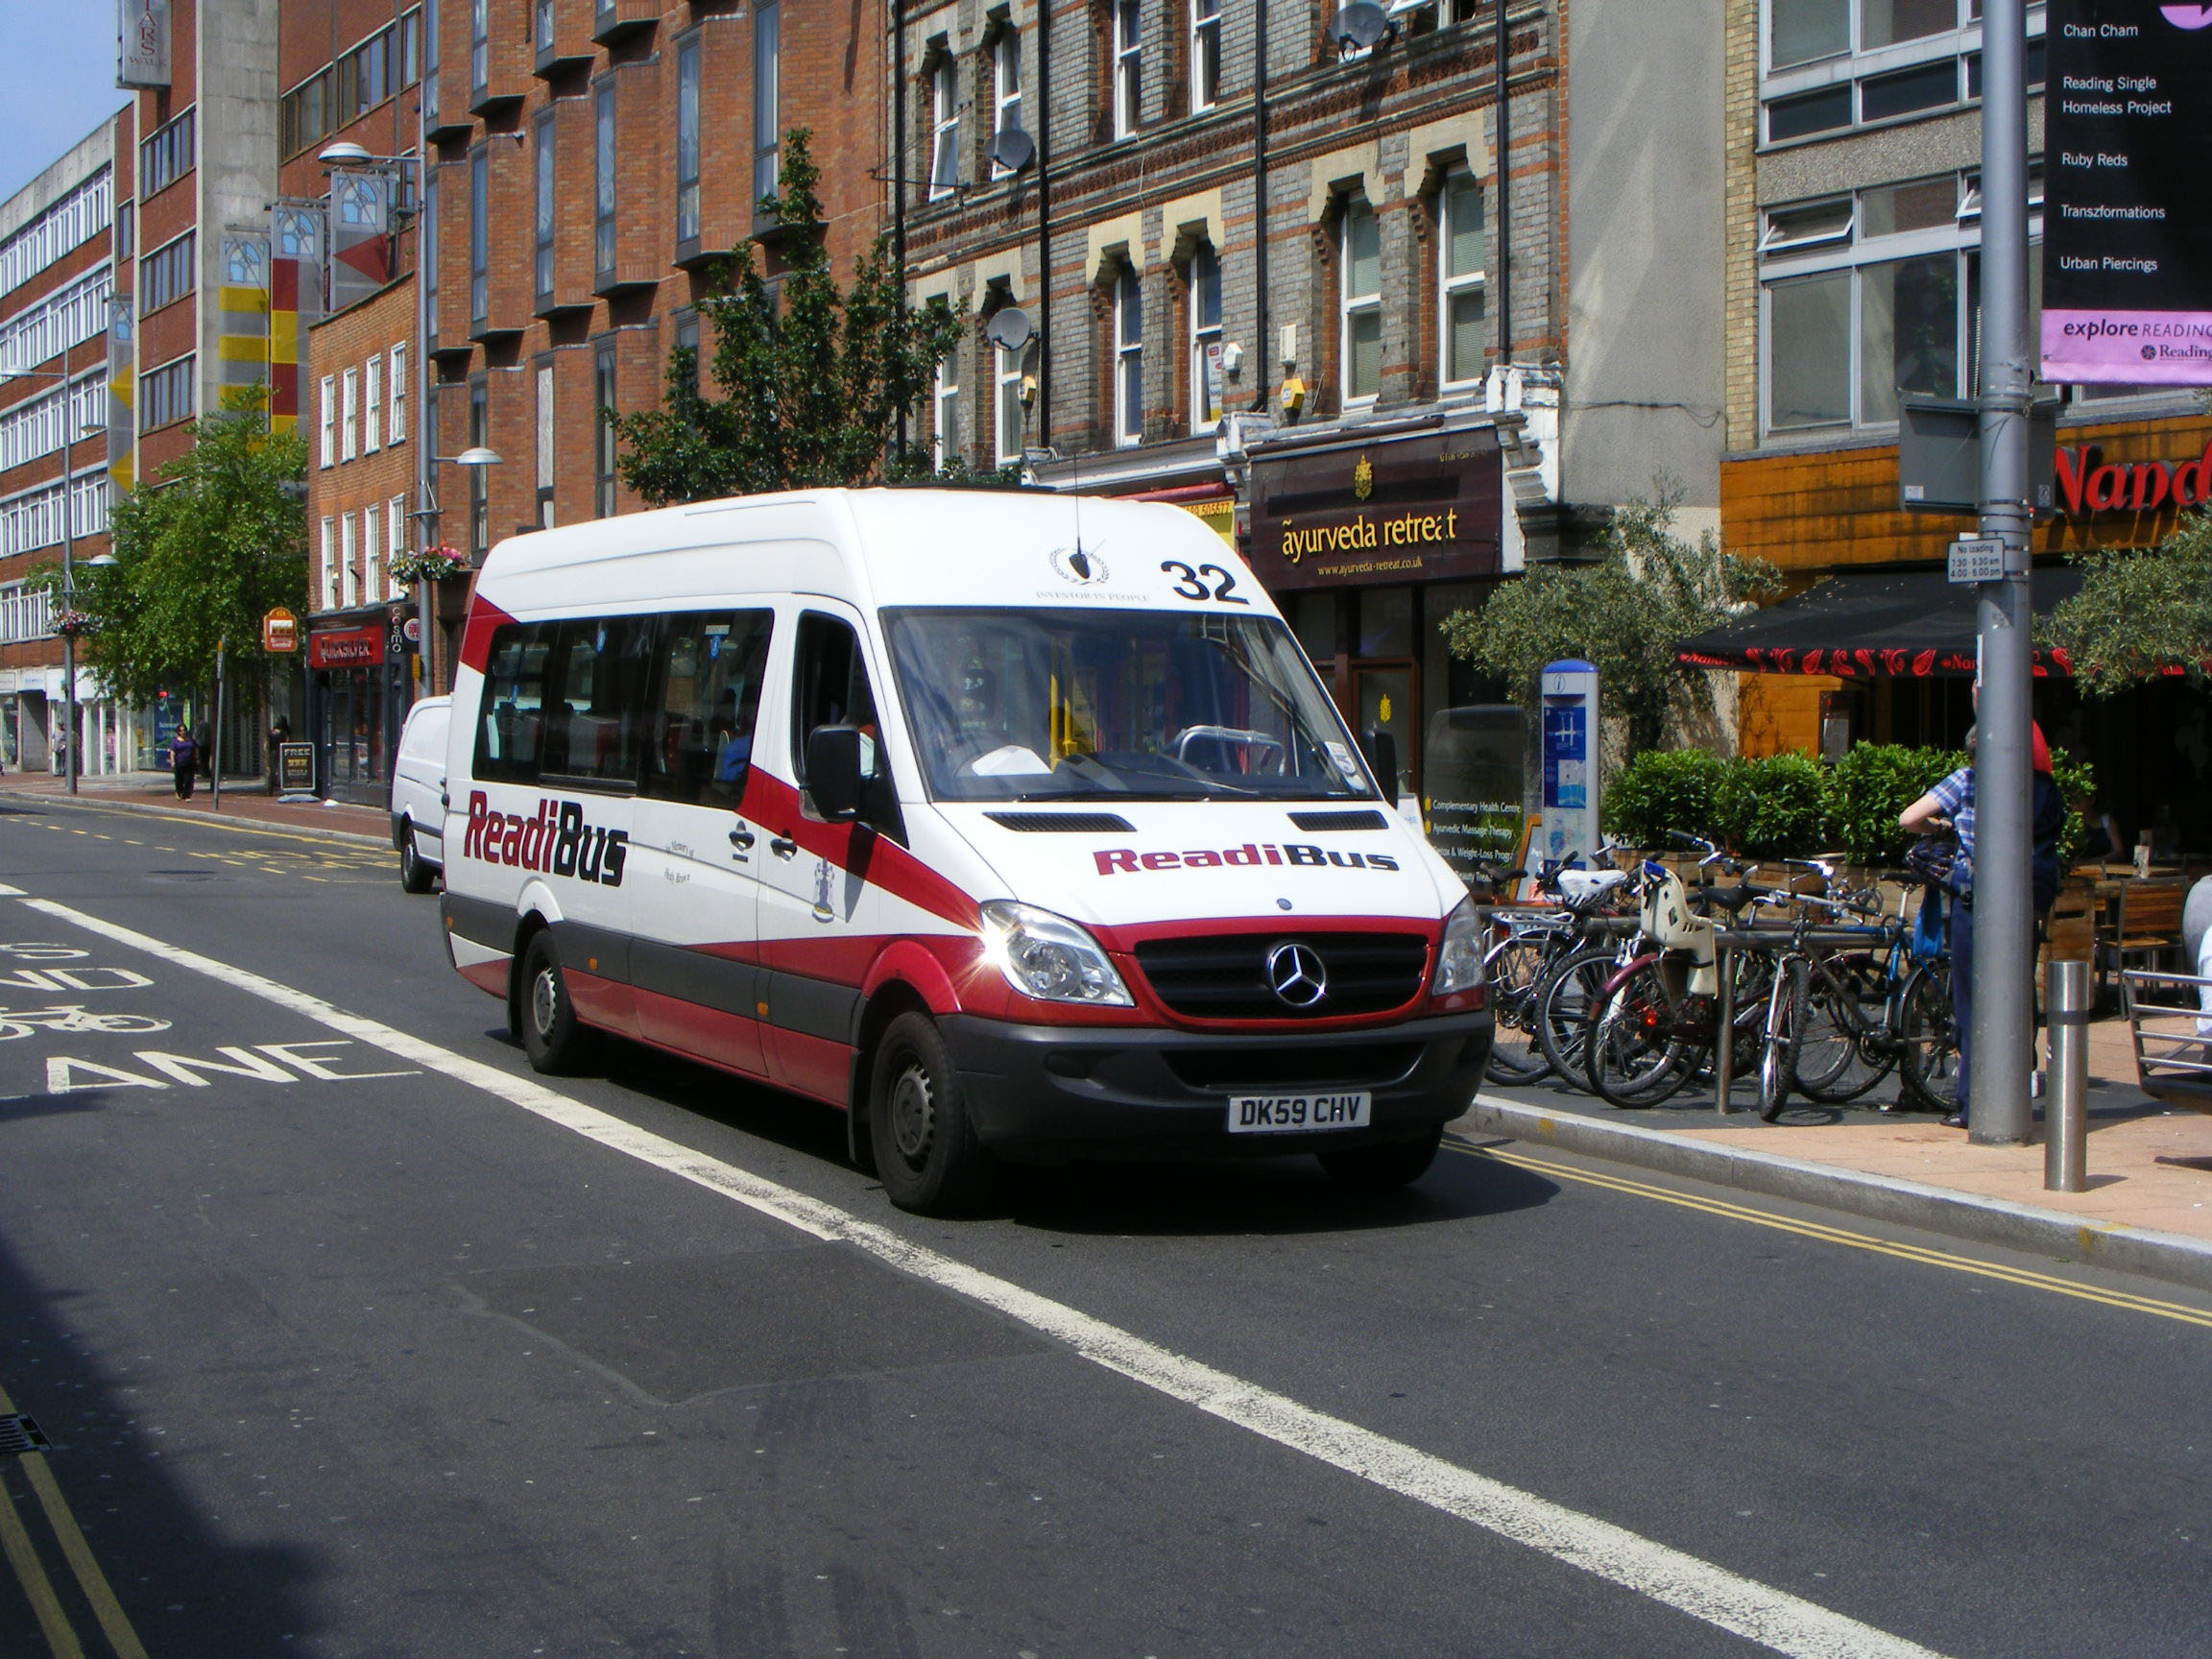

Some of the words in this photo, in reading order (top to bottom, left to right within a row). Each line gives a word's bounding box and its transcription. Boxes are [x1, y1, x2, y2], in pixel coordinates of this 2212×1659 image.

[2063, 24, 2096, 37] Chan
[2100, 24, 2139, 37] Cham
[2063, 76, 2114, 93] Reading
[2117, 76, 2157, 92] Single
[2062, 100, 2124, 114] Homeless
[2128, 100, 2172, 117] Project
[2061, 152, 2094, 169] Ruby
[2097, 153, 2128, 167] Reds
[2060, 204, 2166, 219] Transzformations
[2060, 255, 2099, 270] Urban
[2103, 256, 2158, 274] Piercings
[2063, 318, 2139, 342] explore
[1201, 501, 1230, 517] 505677
[1282, 518, 1378, 565] ãyurveda
[1969, 544, 1994, 554] loading
[1317, 556, 1423, 577] www.ayurveda-retreat.co.uk
[1161, 561, 1250, 606] 32
[1037, 590, 1092, 600] INVESTOR
[1107, 591, 1150, 603] PEOPLE
[1432, 799, 1479, 814] Complementary
[1479, 801, 1500, 812] Health
[1501, 802, 1522, 814] Centre
[464, 790, 629, 887] ReadiBus
[1432, 823, 1460, 836] Ayurvedic
[1461, 824, 1488, 837] Massage
[1489, 826, 1514, 840] Therapy
[1093, 843, 1400, 876] ReadiBus
[1457, 847, 1494, 860] Weight-Loss
[1239, 1099, 1308, 1126] DK59
[1313, 1095, 1361, 1123] CHV
